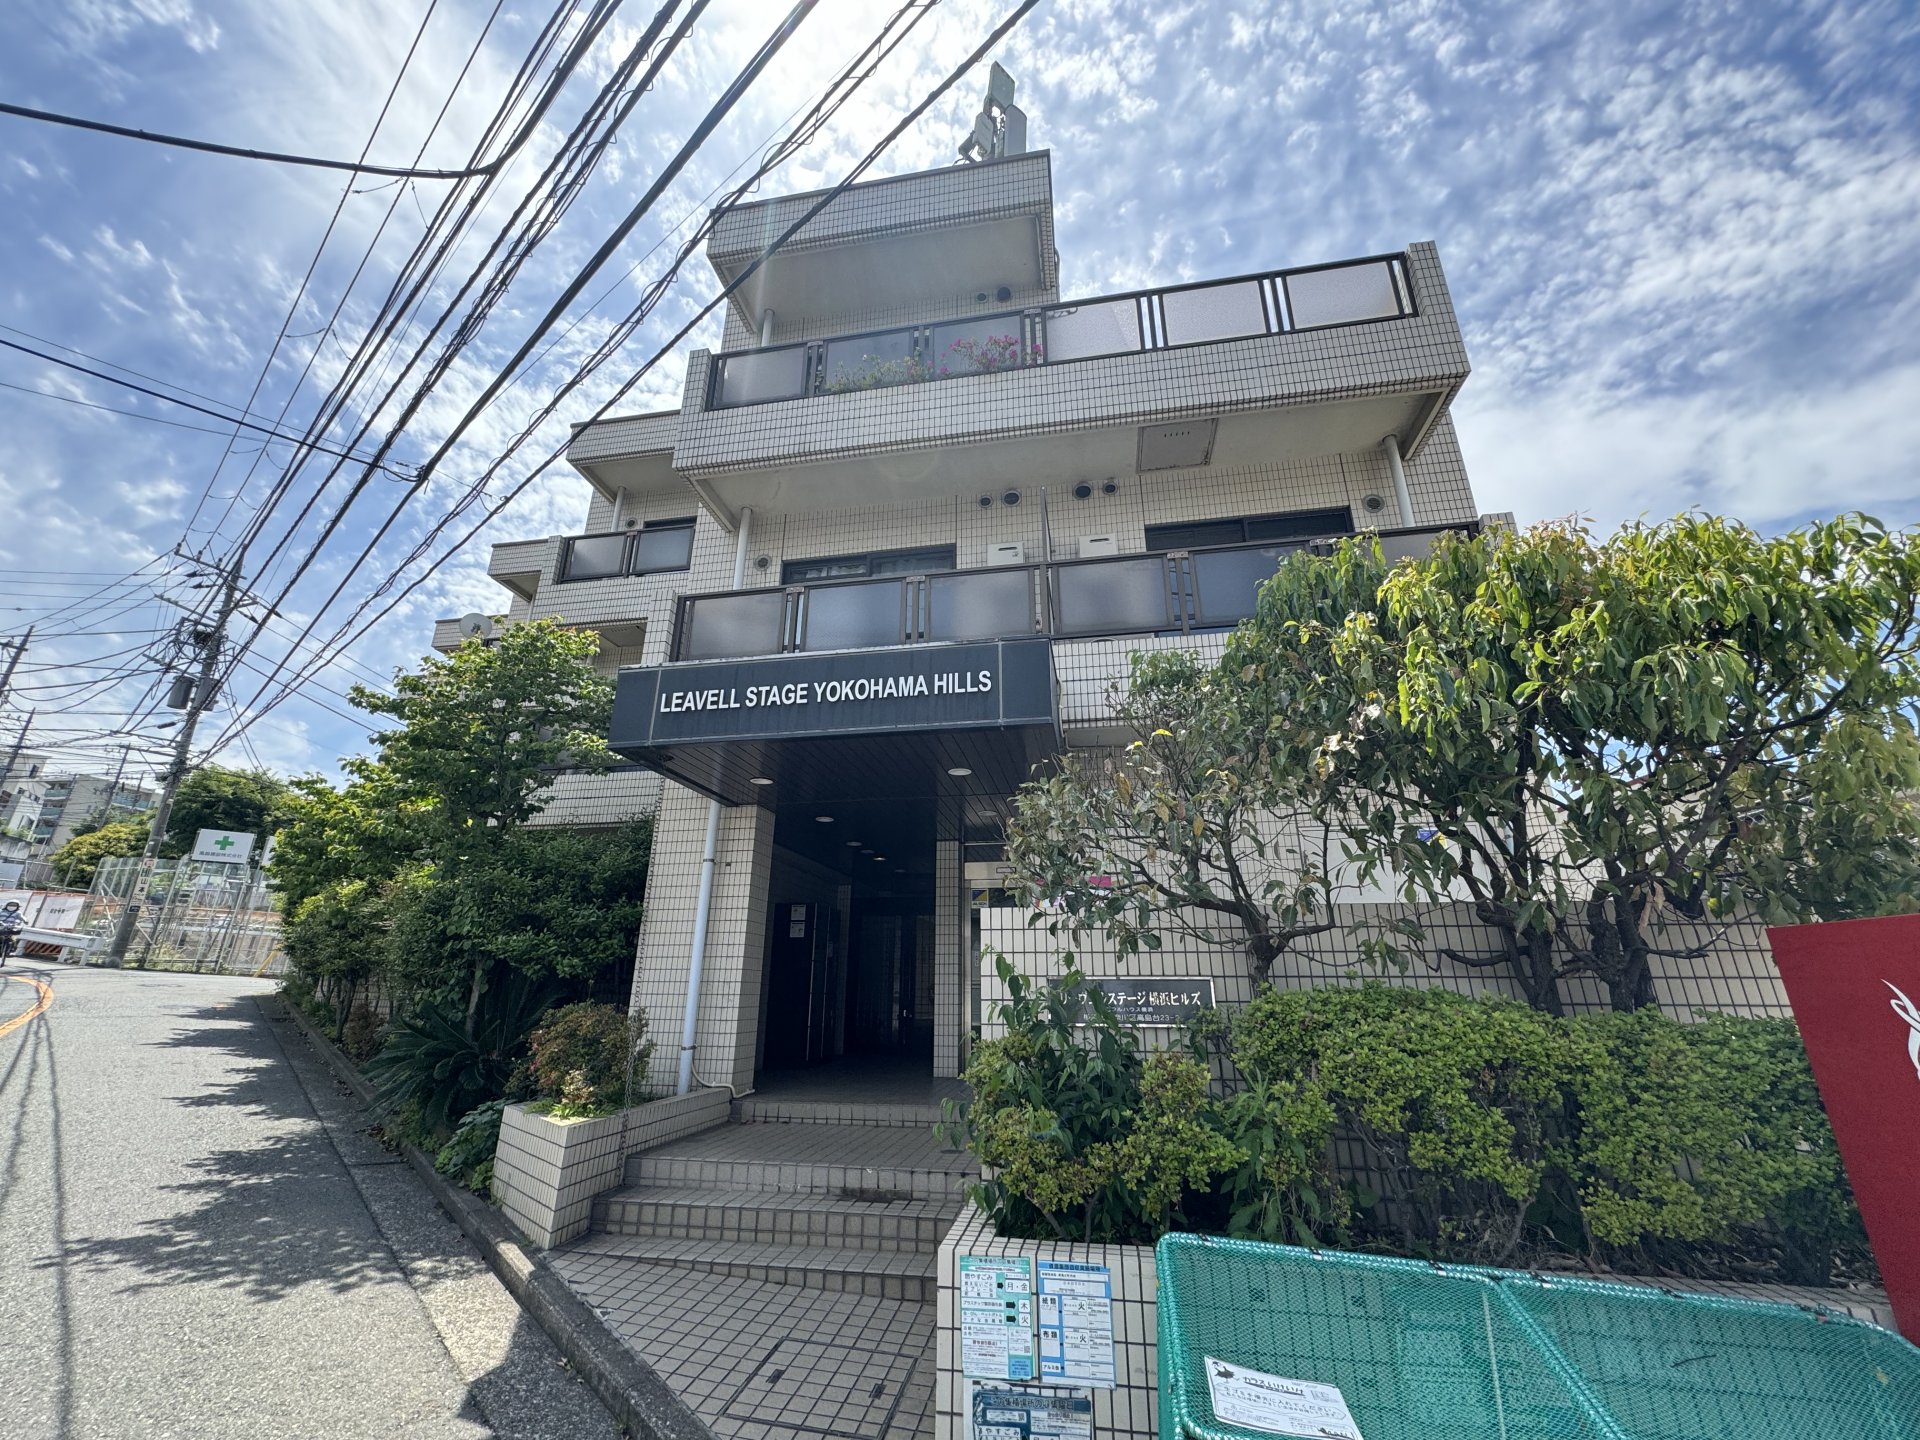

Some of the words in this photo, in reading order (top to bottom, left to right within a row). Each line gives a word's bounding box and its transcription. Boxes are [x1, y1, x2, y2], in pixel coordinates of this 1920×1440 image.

[660, 688, 741, 714] LEAVELL
[745, 682, 809, 709] STAGE
[813, 674, 927, 704] YOKOHAMA
[934, 669, 993, 696] HILLS
[1042, 1297, 1057, 1305] 紙類
[1020, 1302, 1029, 1311] 木
[1021, 1316, 1029, 1325] 火
[1042, 1330, 1058, 1339] 布類
